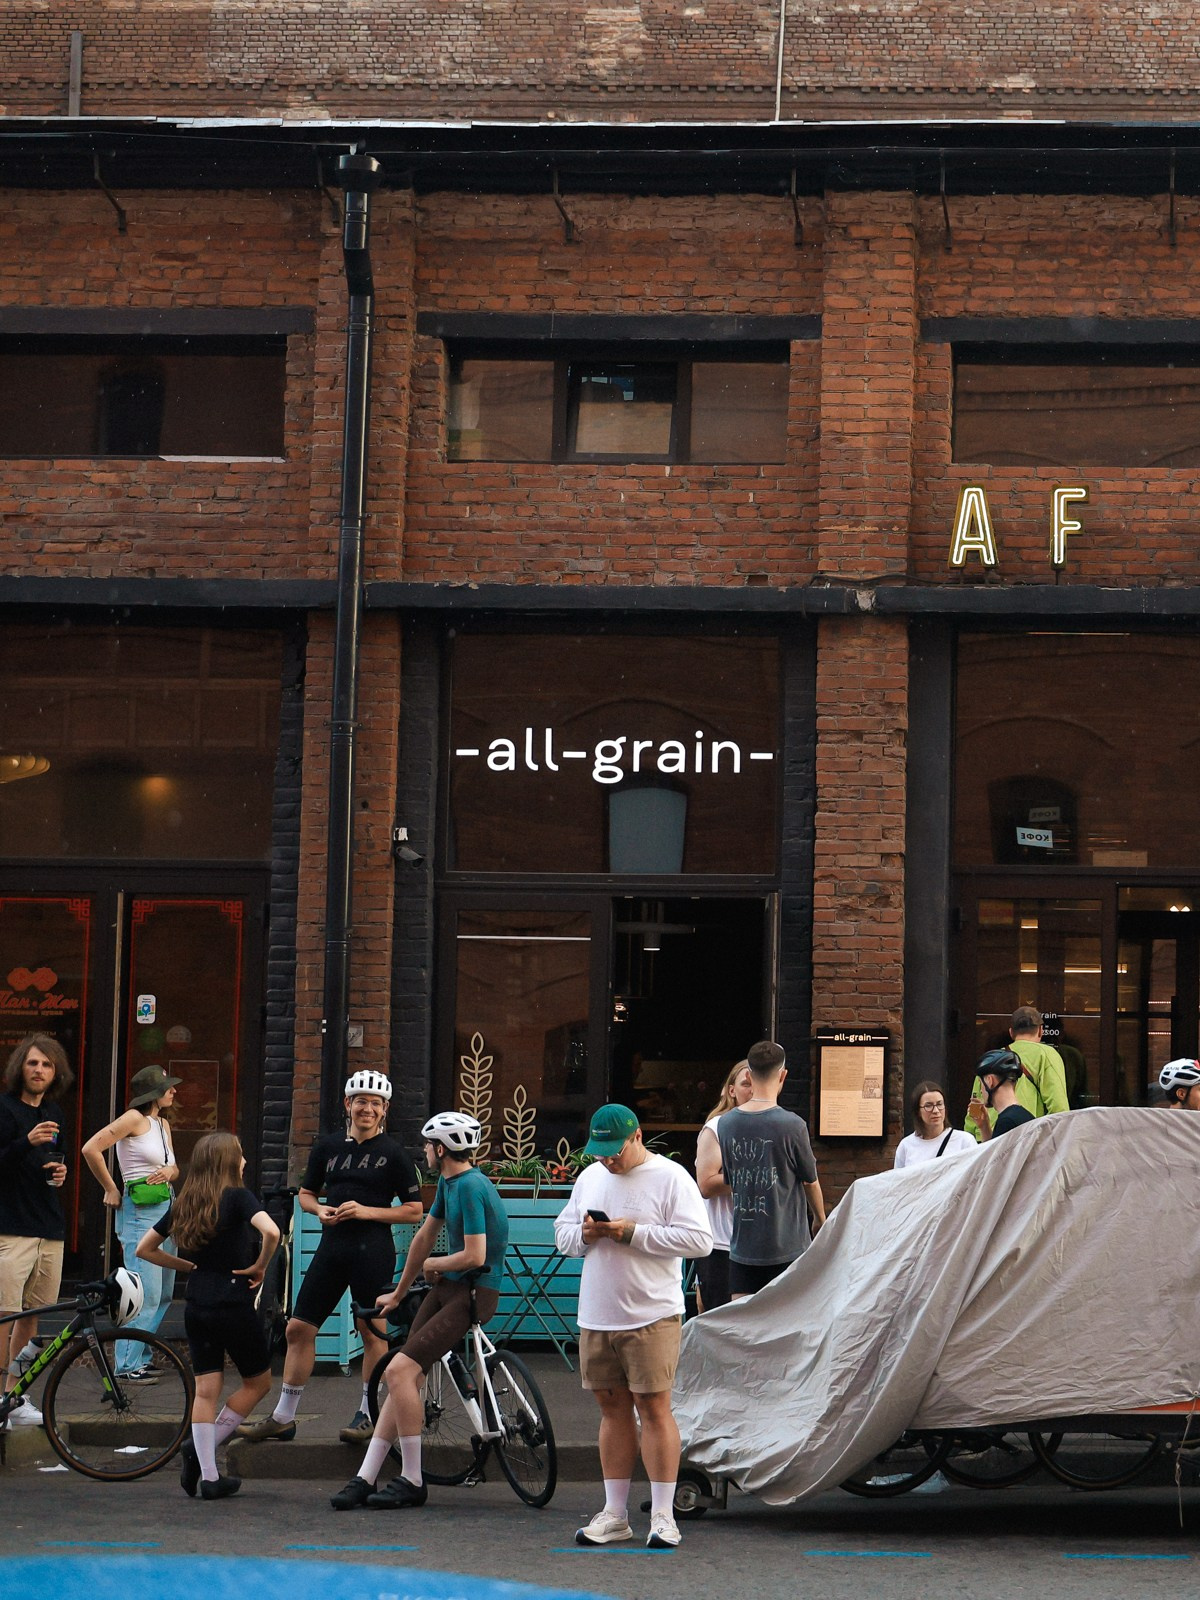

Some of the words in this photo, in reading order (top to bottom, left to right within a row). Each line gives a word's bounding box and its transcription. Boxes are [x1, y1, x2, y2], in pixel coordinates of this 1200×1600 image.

[948, 484, 1089, 570] AF
[326, 1153, 388, 1173] MAAP
[7, 1324, 74, 1397] TREK
